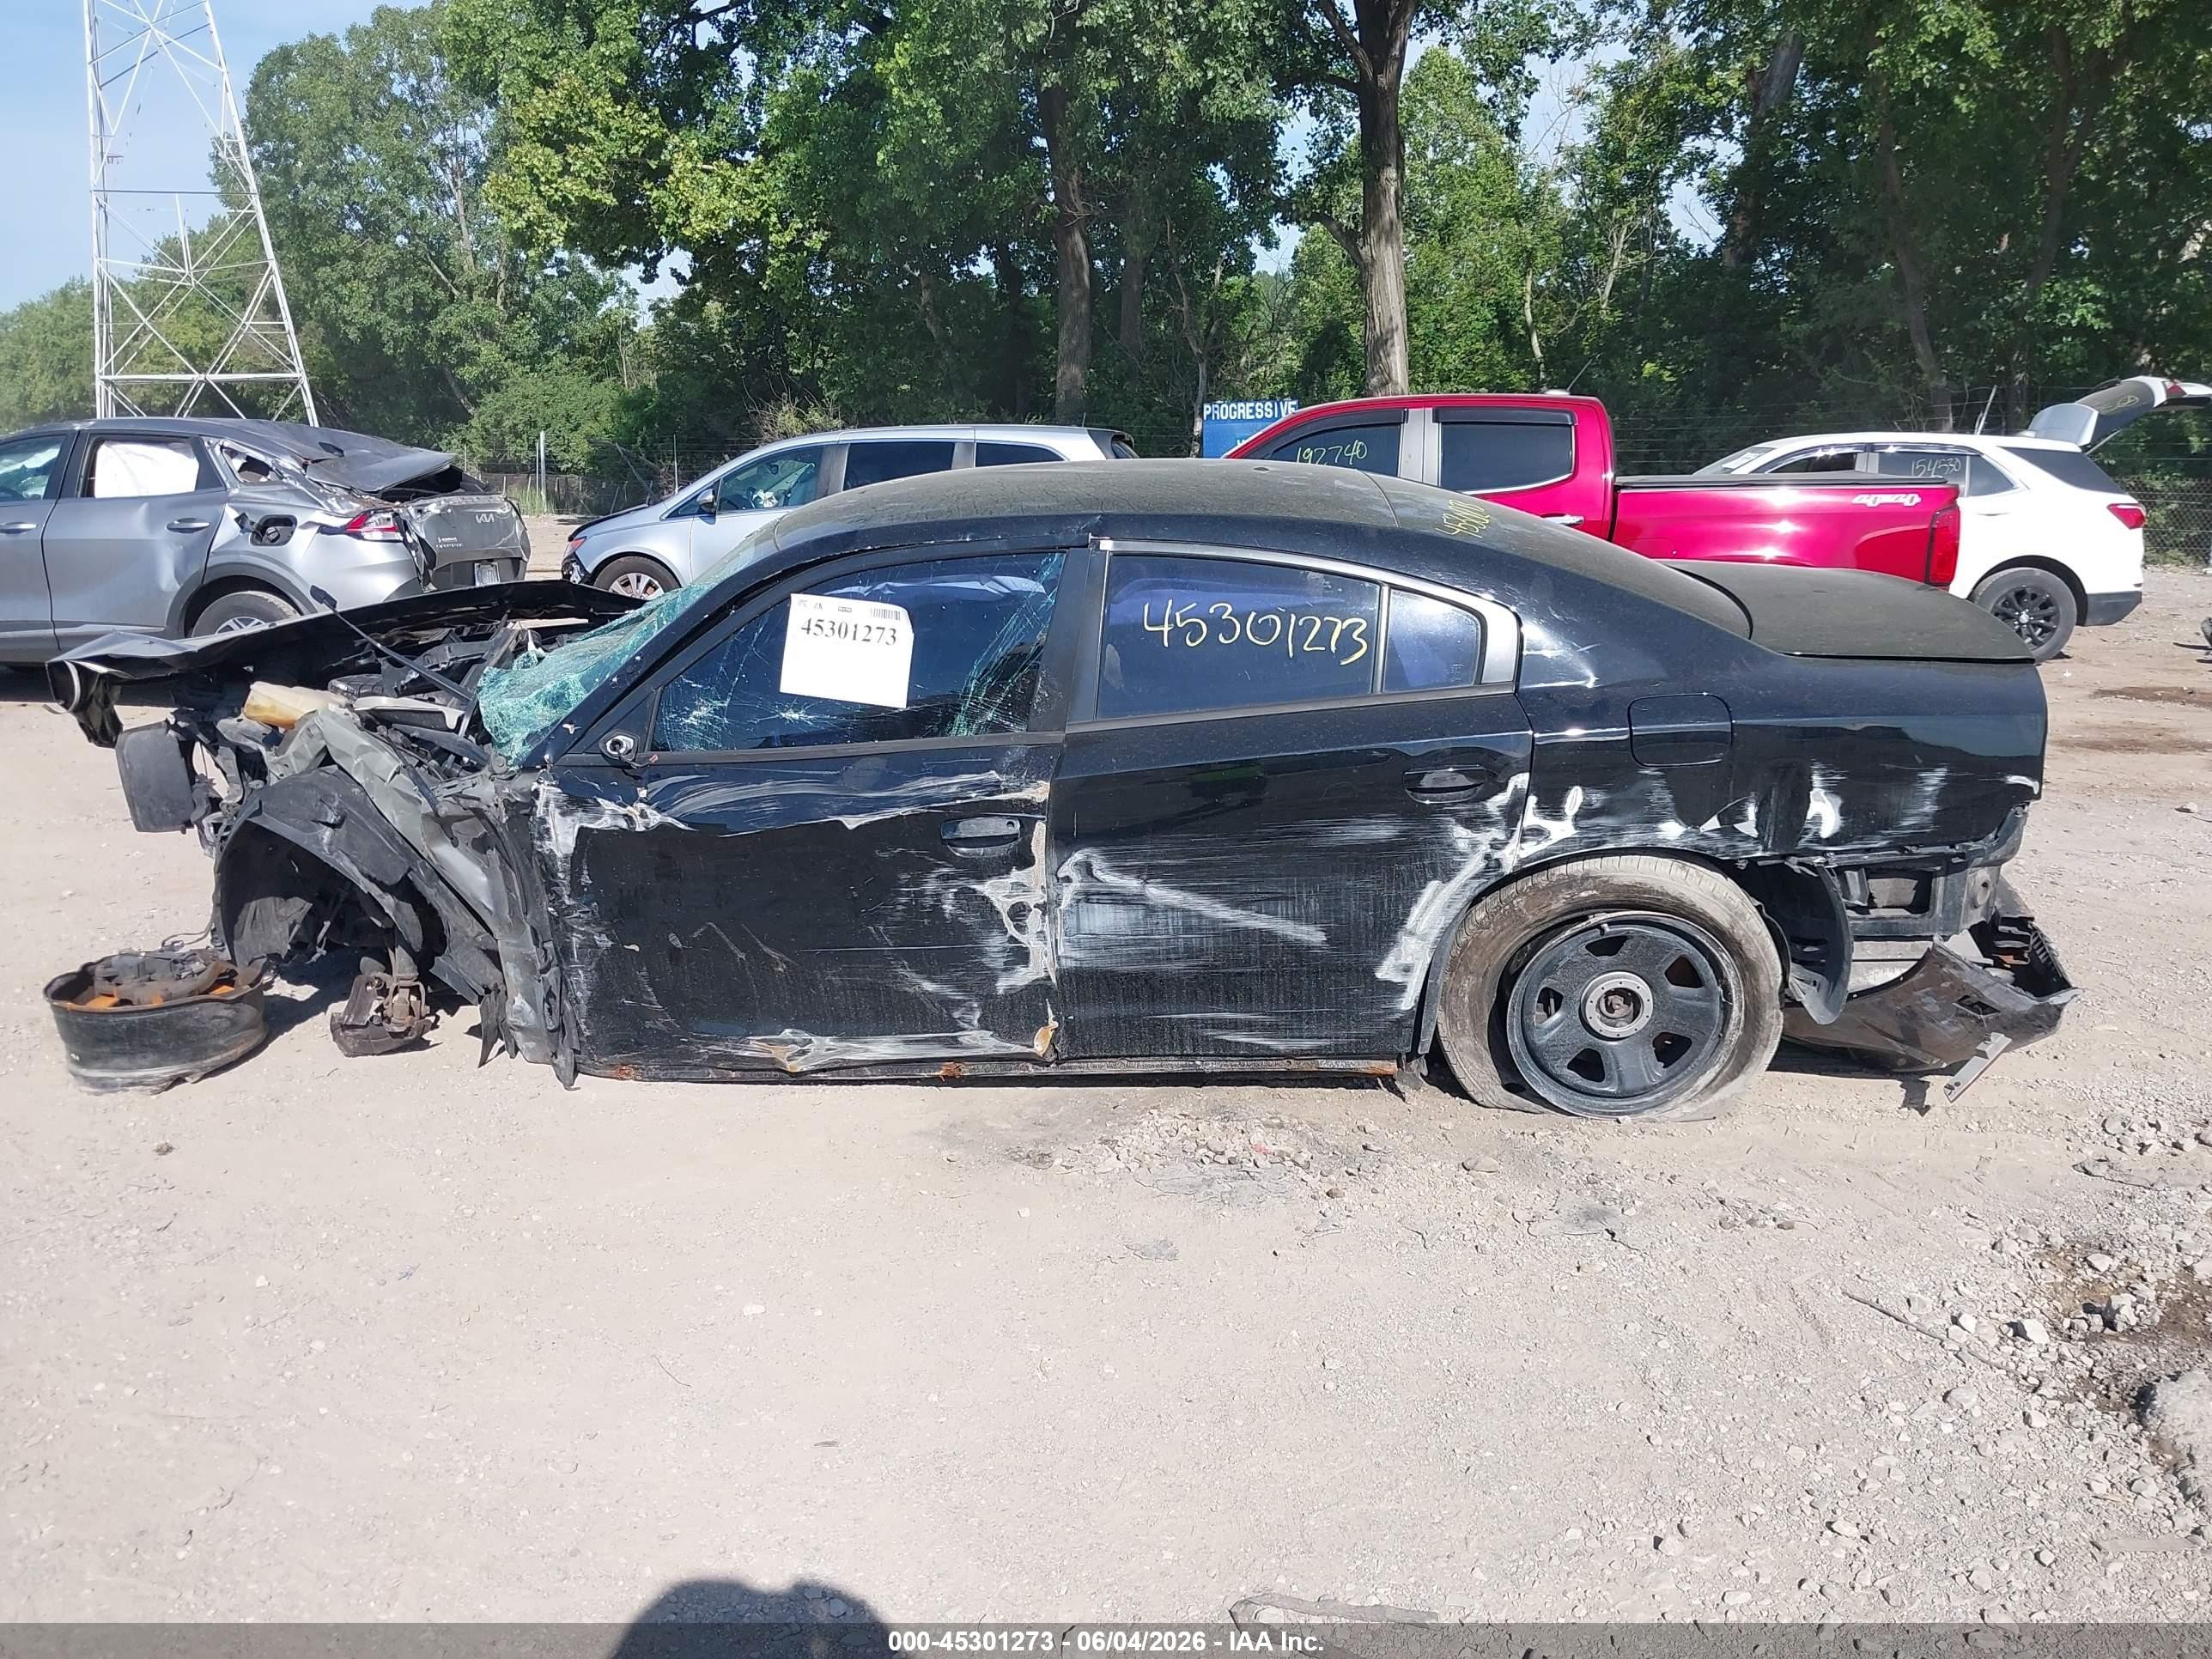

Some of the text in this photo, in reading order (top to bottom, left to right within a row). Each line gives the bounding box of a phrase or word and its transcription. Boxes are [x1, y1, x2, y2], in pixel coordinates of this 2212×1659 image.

[1296, 439, 1368, 465] 192740
[800, 617, 896, 646] 45301273
[1143, 599, 1368, 665] 45301273
